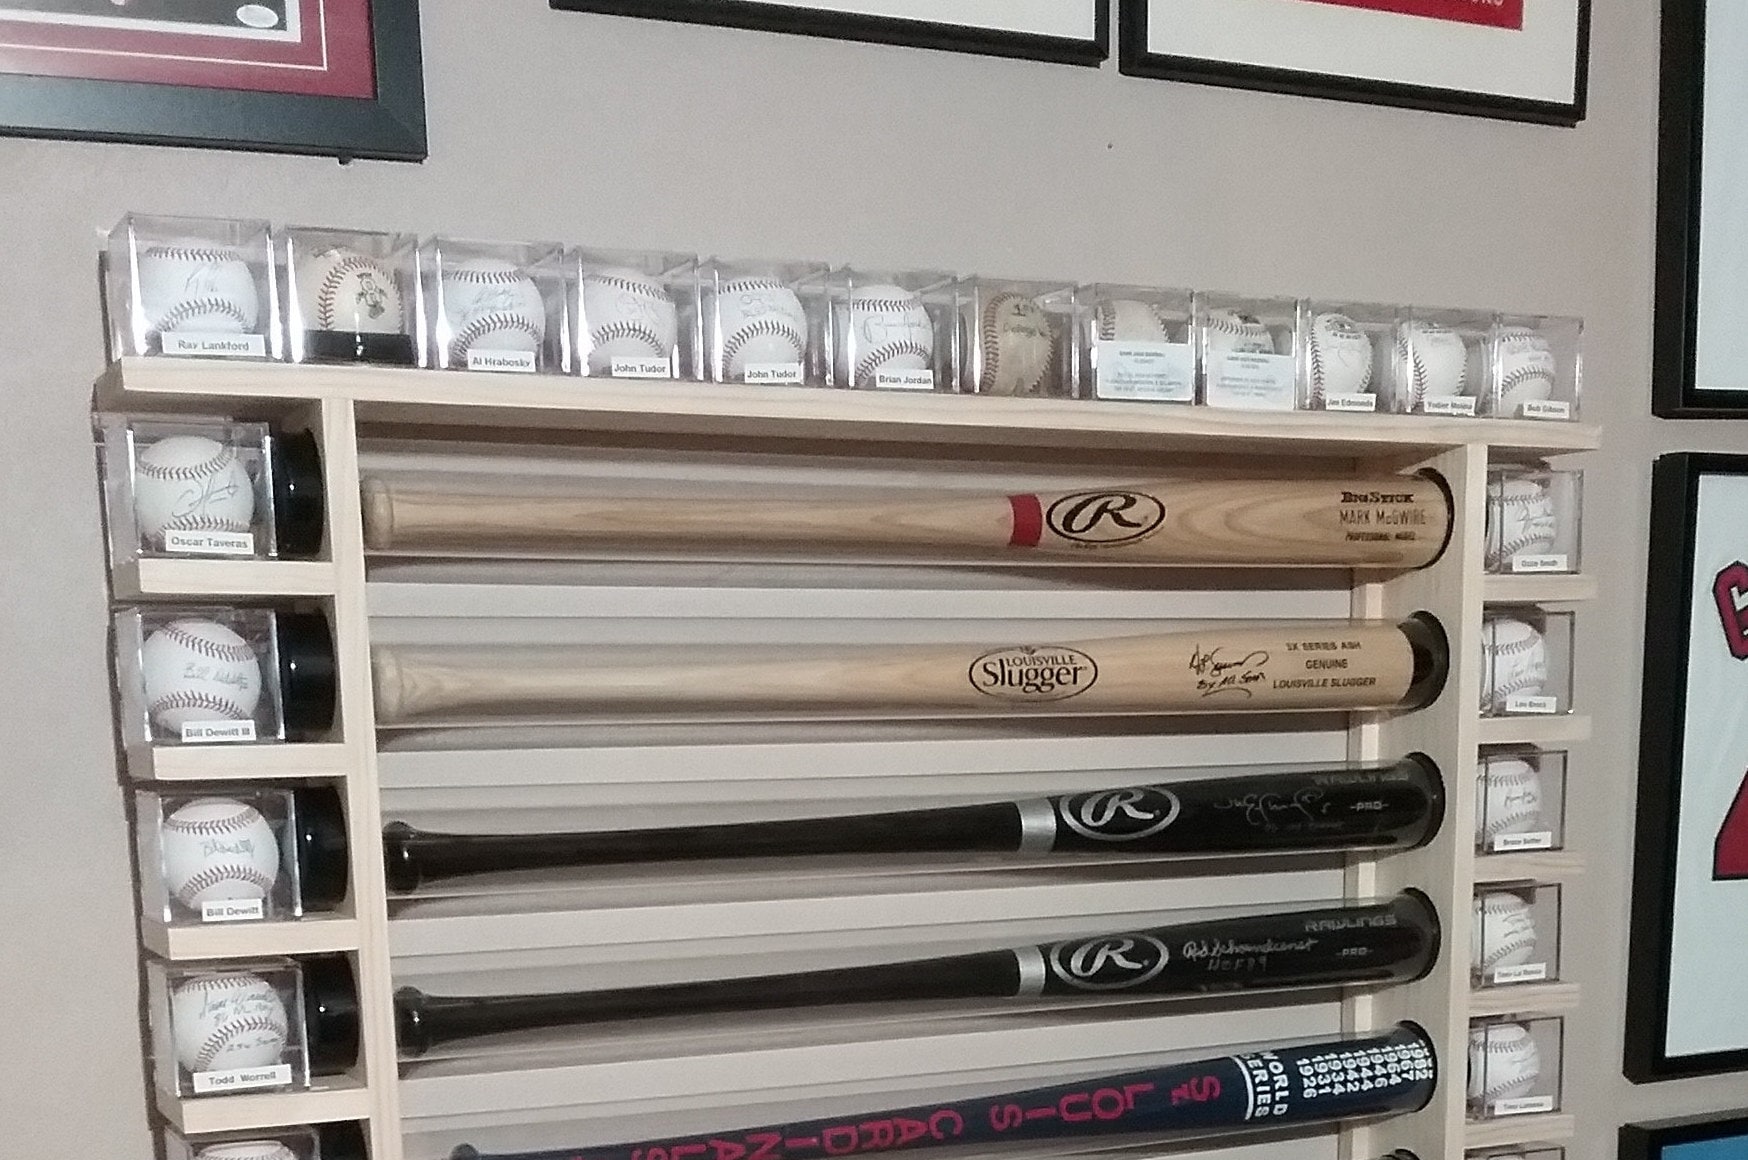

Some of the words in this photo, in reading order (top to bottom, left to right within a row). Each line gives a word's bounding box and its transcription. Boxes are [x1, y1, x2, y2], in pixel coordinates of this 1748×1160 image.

[178, 339, 200, 352] Ray
[202, 341, 249, 352] Lankford
[485, 357, 530, 369] Hrabosky
[614, 364, 638, 373] John
[640, 364, 666, 374] Tudor
[747, 370, 768, 380] John
[771, 370, 796, 380] Tudor
[879, 375, 901, 384] Brian
[903, 376, 932, 386] Jordan
[1340, 509, 1370, 525] MARK
[171, 536, 203, 547] Oscar
[207, 537, 248, 549] Taveras
[1303, 642, 1337, 651] SERIES
[1341, 641, 1361, 650] ASH
[1006, 655, 1077, 668] LOUISVILLE
[1305, 658, 1348, 670] GENUINE
[983, 658, 1083, 694] Slugger
[1273, 678, 1328, 689] LOUISVILLE
[1330, 677, 1376, 689] SLUGGER
[185, 728, 203, 738] Bill
[205, 728, 239, 738] Dewitt
[207, 908, 224, 917] Bill
[227, 907, 259, 917] Dewitt
[1367, 1047, 1388, 1088] 1946
[1381, 1046, 1402, 1086] 1964
[1395, 1044, 1414, 1081] 1967
[1311, 1056, 1332, 1094] 1931
[1325, 1053, 1346, 1096] 1934
[1340, 1052, 1360, 1093] 1942
[1353, 1050, 1374, 1092] 1944
[208, 1075, 235, 1086] Todd
[240, 1071, 276, 1083] Worrell
[1296, 1058, 1317, 1099] 1926
[991, 1082, 1155, 1133] LOUIS
